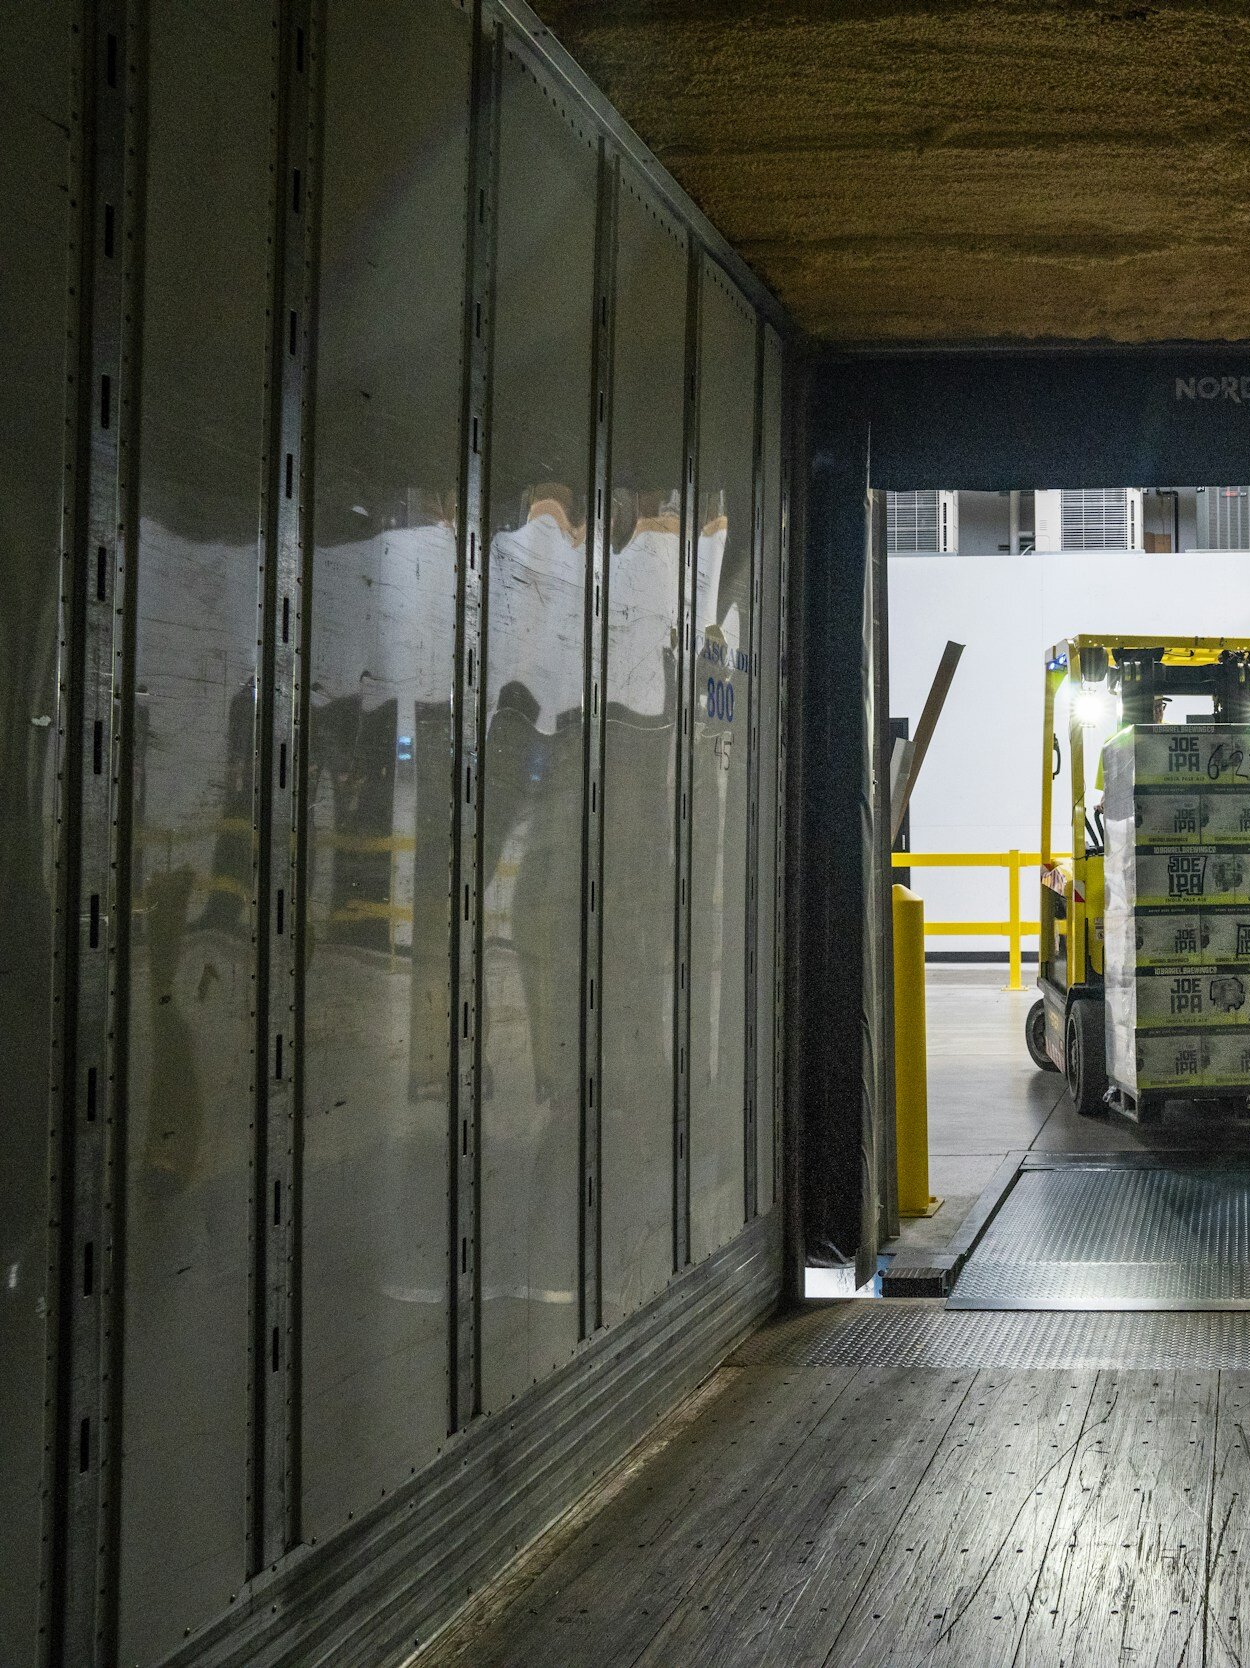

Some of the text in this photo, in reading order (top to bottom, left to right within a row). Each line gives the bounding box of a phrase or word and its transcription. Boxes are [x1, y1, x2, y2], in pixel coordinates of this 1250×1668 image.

[707, 677, 734, 722] 800
[1169, 737, 1199, 752] JOE
[1169, 753, 1200, 772] IPA
[1174, 809, 1195, 819] JOE
[1174, 820, 1195, 833] IPA
[1169, 857, 1201, 872] JOE
[1169, 873, 1201, 893] IPA
[1175, 929, 1195, 939] JOE
[1175, 940, 1196, 953] IPA
[1170, 979, 1201, 993] JOE
[1170, 994, 1202, 1013] IPA
[1176, 1061, 1197, 1074] IPA
